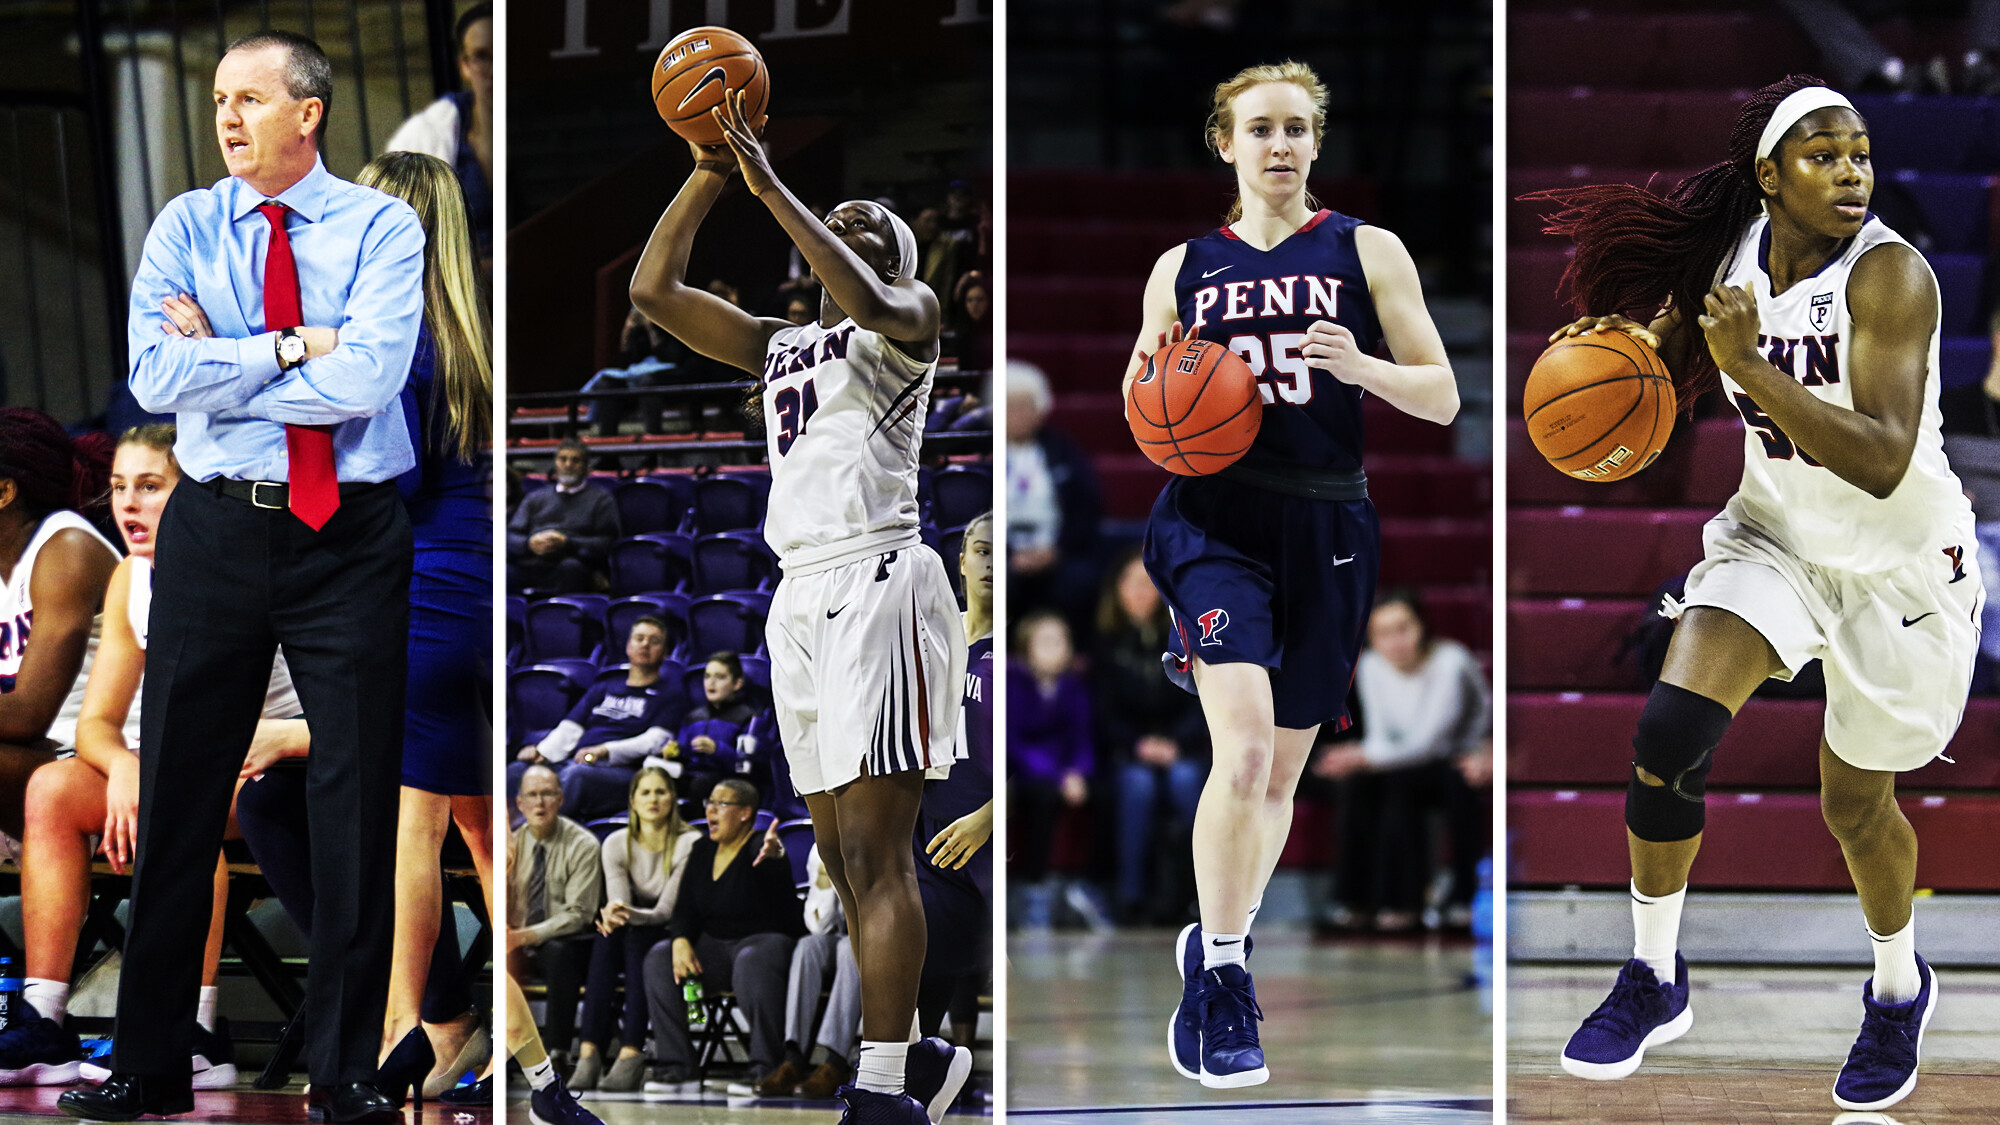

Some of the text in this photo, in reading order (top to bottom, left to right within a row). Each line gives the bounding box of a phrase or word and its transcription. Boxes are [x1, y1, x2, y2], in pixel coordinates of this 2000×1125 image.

[1193, 274, 1344, 328] PENN
[1227, 332, 1315, 407] 25
[774, 378, 819, 457] 31
[1733, 391, 1826, 467] 5
[1197, 608, 1230, 646] P
